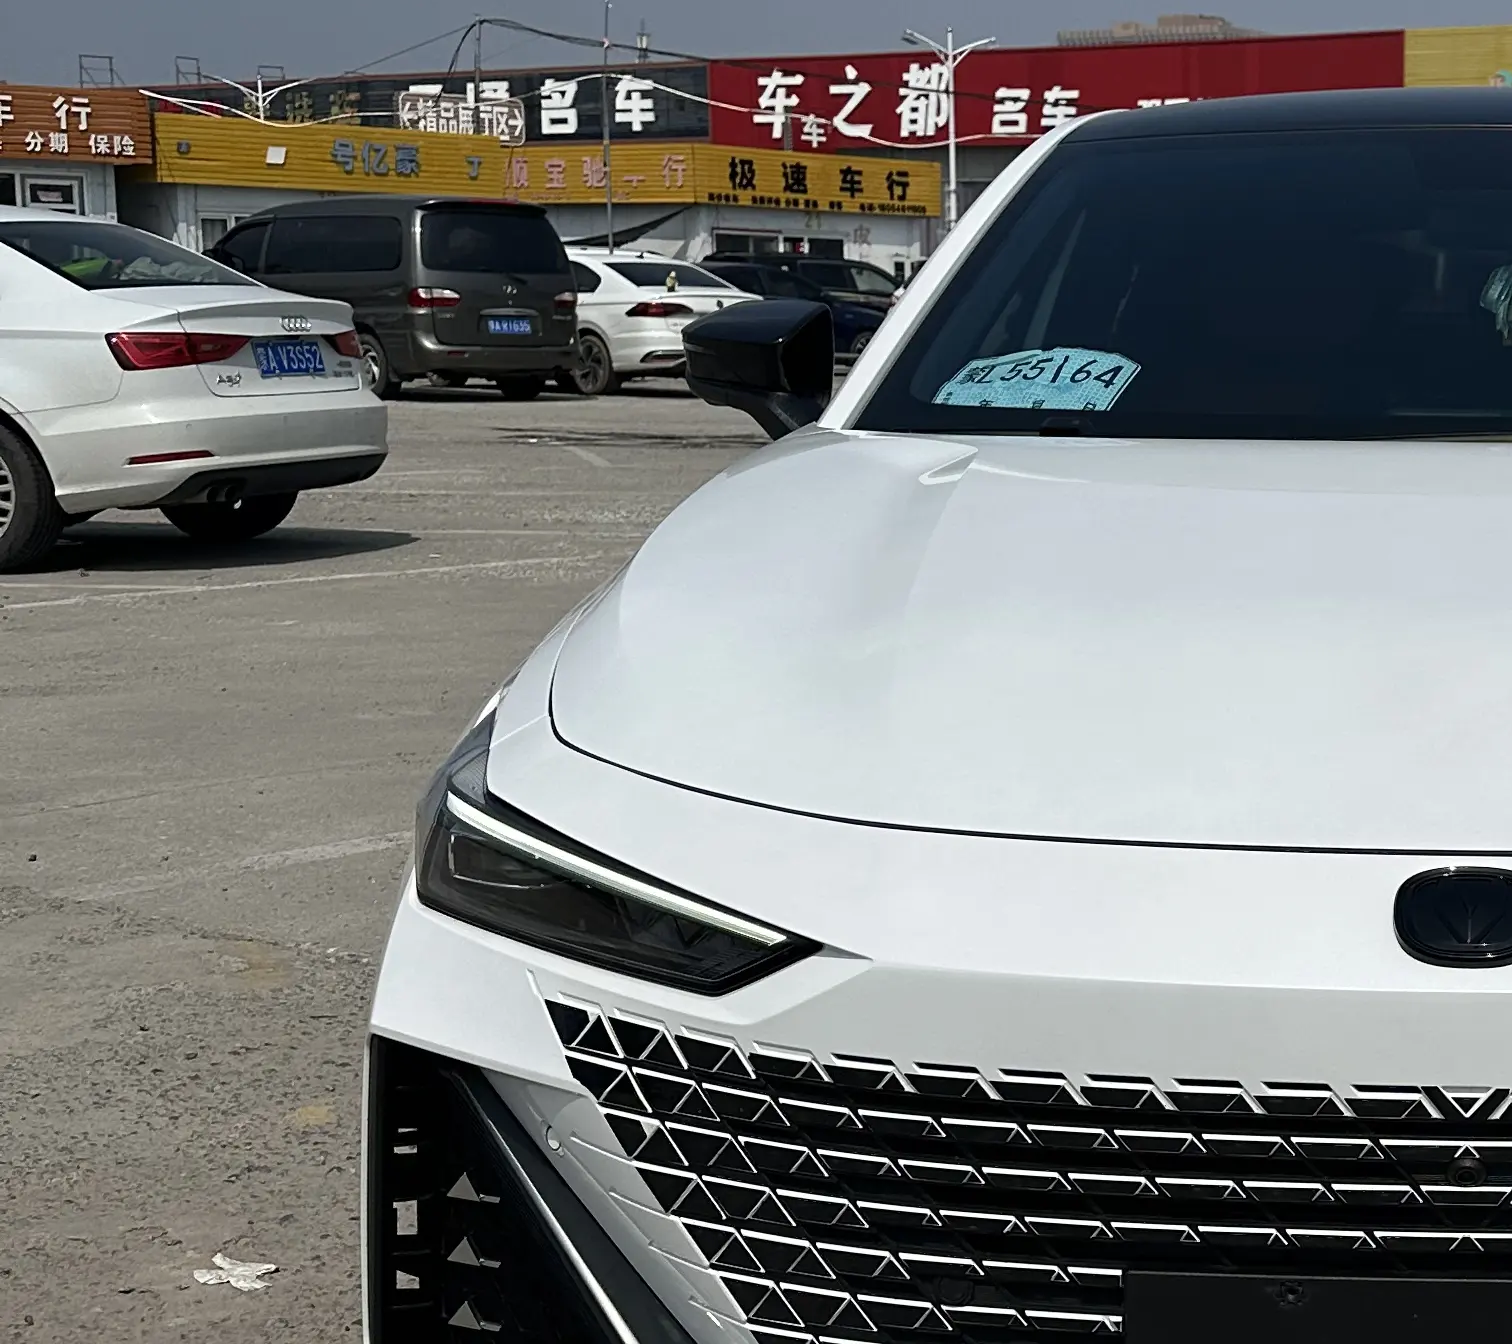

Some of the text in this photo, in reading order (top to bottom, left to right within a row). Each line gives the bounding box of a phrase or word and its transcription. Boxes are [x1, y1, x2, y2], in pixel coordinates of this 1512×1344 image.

[753, 63, 949, 139] 车之都
[991, 85, 1080, 134] 名车
[24, 131, 136, 156] 分期 保险
[728, 156, 911, 202] 极速车行
